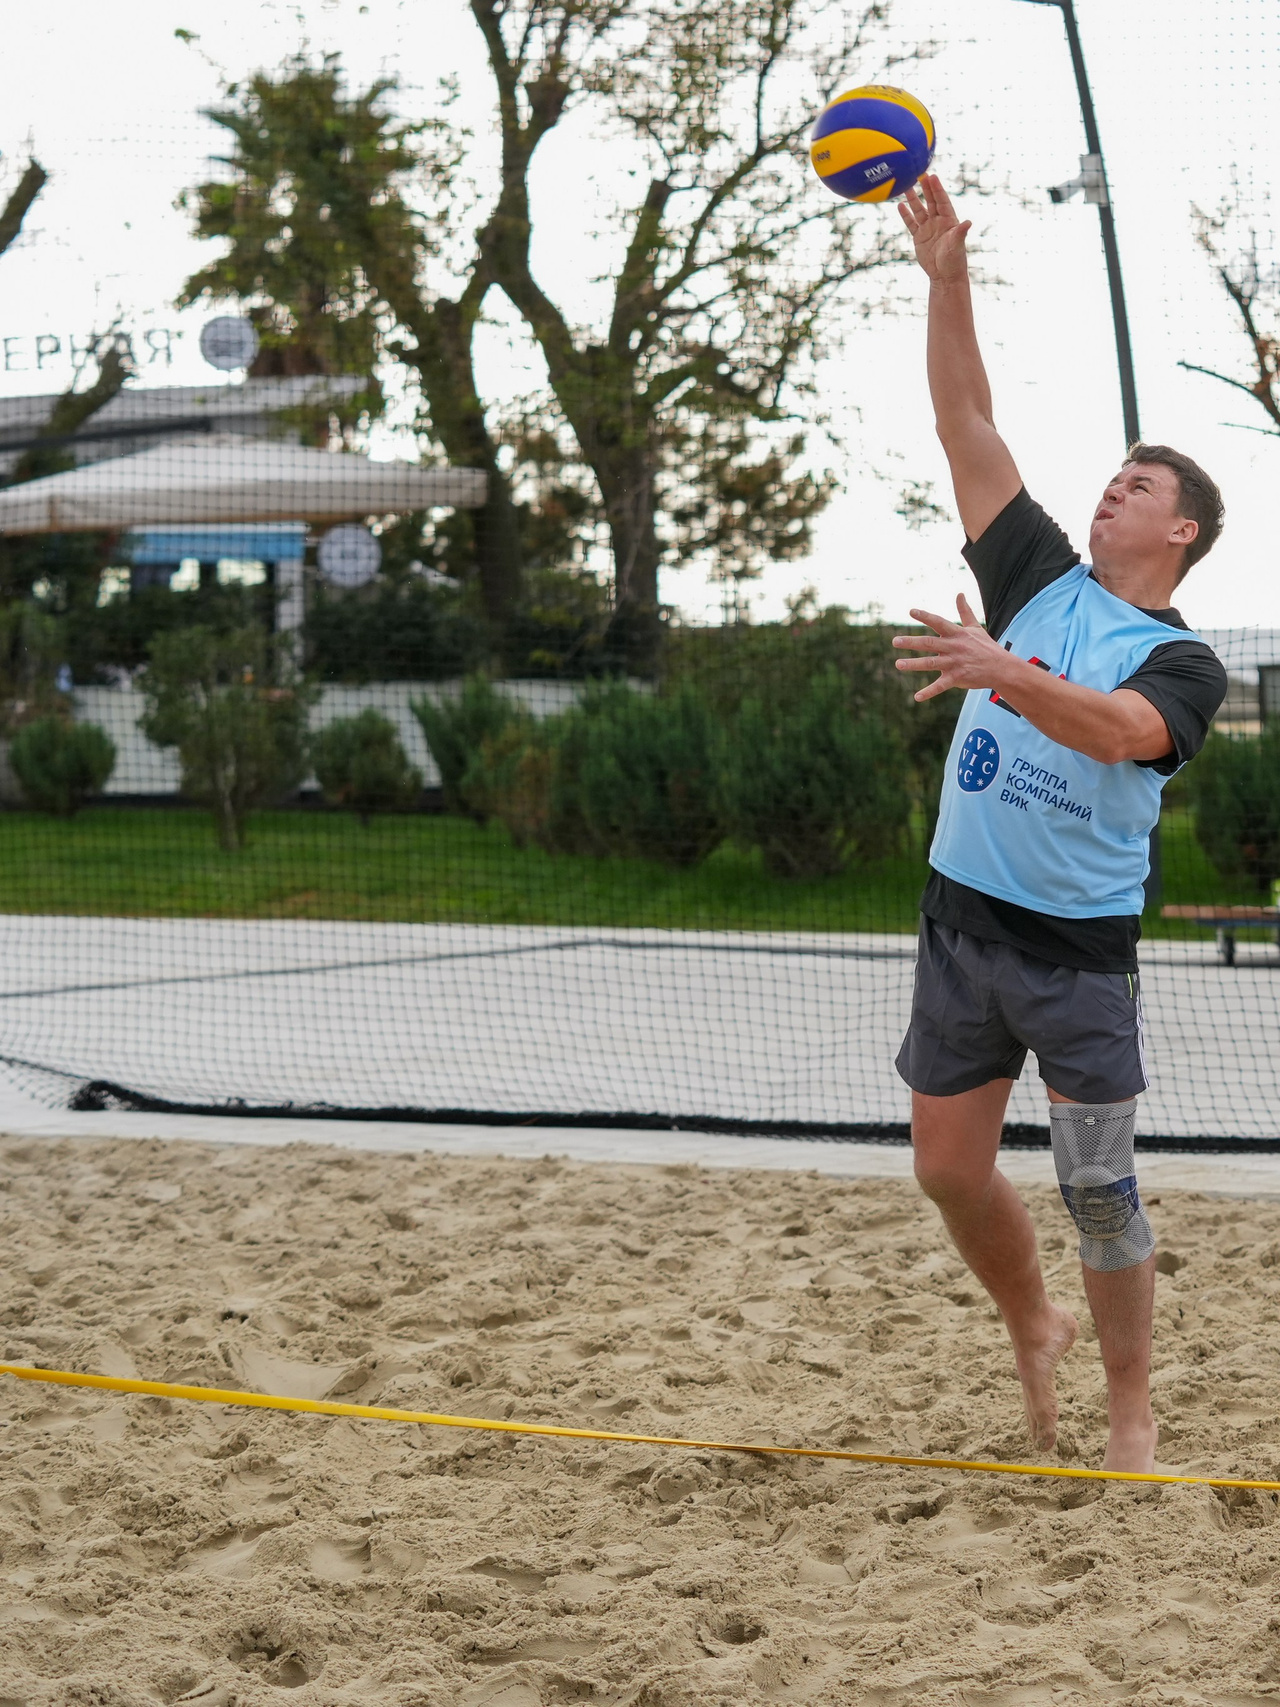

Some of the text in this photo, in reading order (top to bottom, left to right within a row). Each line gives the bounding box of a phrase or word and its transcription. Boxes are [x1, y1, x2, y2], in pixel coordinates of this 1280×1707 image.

[1011, 757, 1068, 793] ГРУППА
[1000, 788, 1030, 812] ВИК
[1006, 772, 1093, 822] КОМПАНИЙ
